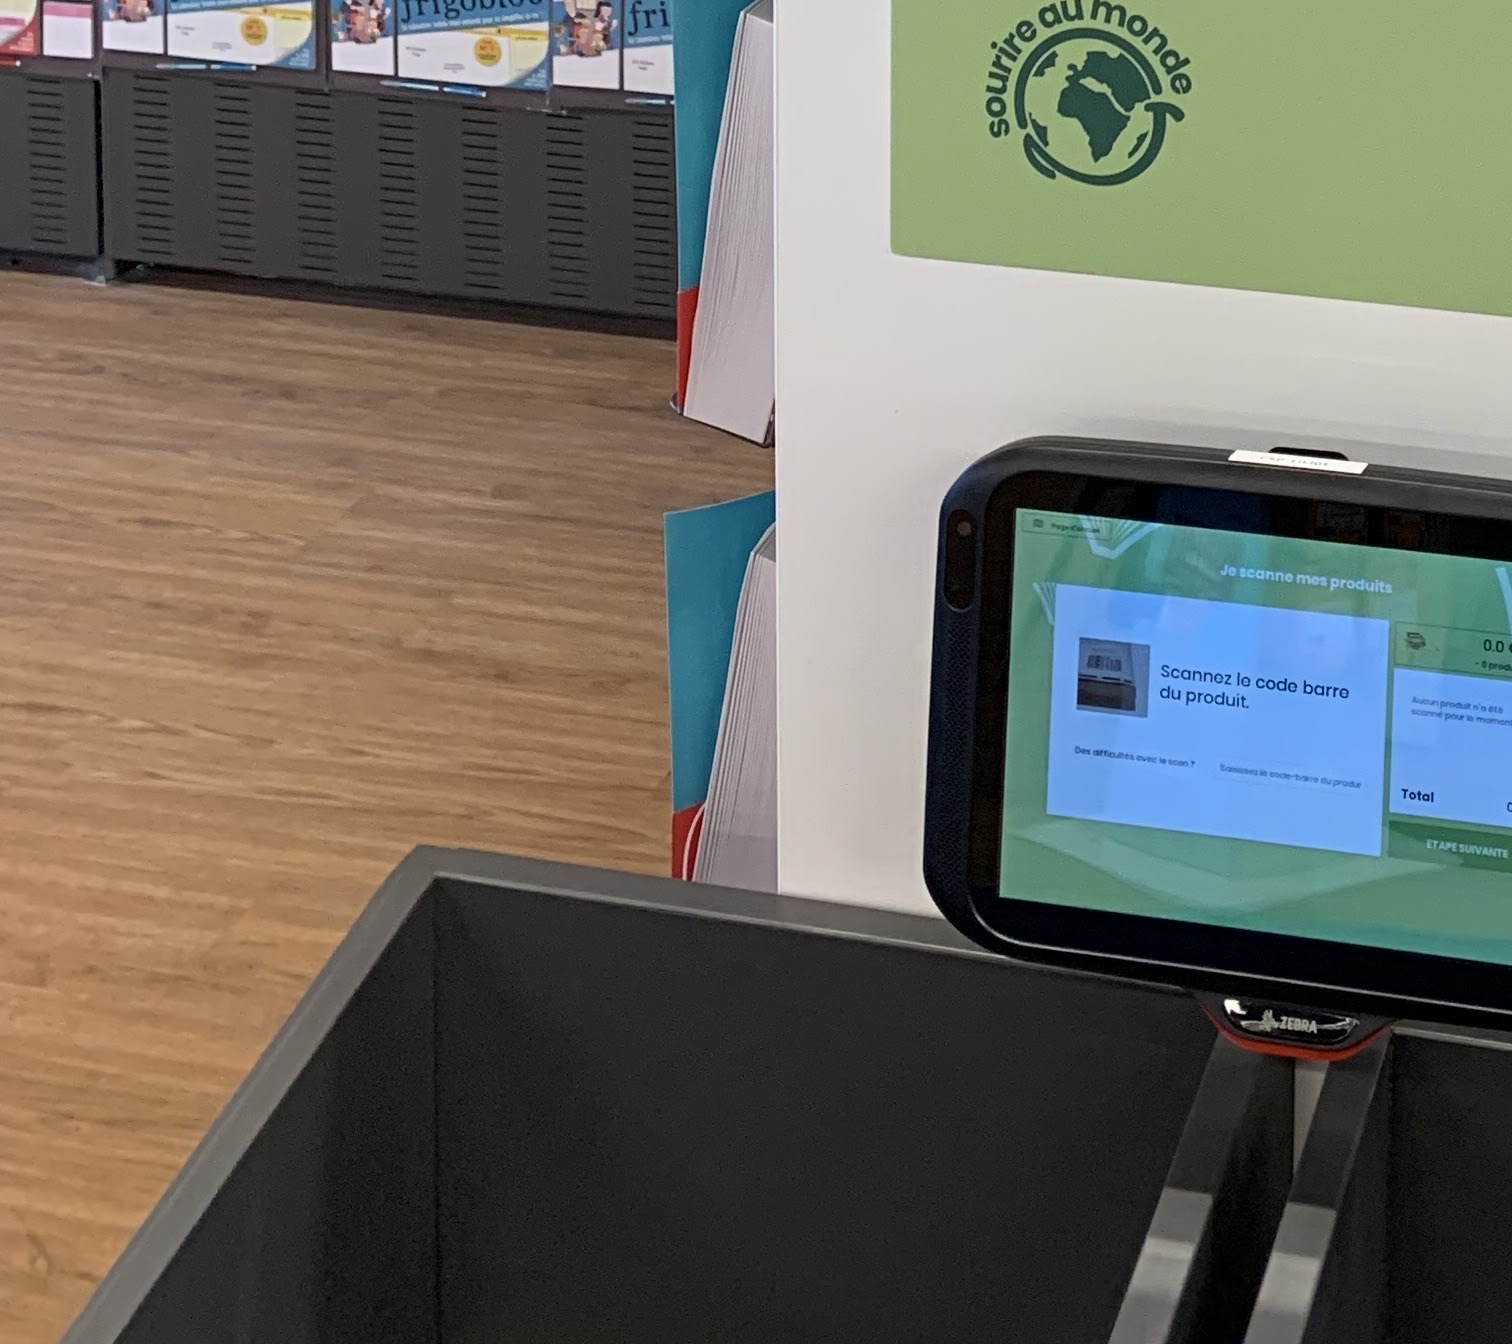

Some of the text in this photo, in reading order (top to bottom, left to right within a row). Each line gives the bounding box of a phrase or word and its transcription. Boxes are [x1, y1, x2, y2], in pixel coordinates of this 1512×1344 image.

[627, 0, 672, 36] fri
[985, 19, 1037, 138] sourire
[1220, 564, 1393, 594] Je scanne mes produits
[1483, 638, 1504, 655] 0.0
[1160, 664, 1350, 699] Scannez le code barre
[1160, 686, 1250, 710] du produit.
[1440, 699, 1471, 711] produit
[1444, 711, 1465, 722] pour
[1401, 788, 1435, 803] Total
[1426, 838, 1509, 859] ETAPE SUIVANTE
[1279, 1015, 1318, 1034] ZEBRA
